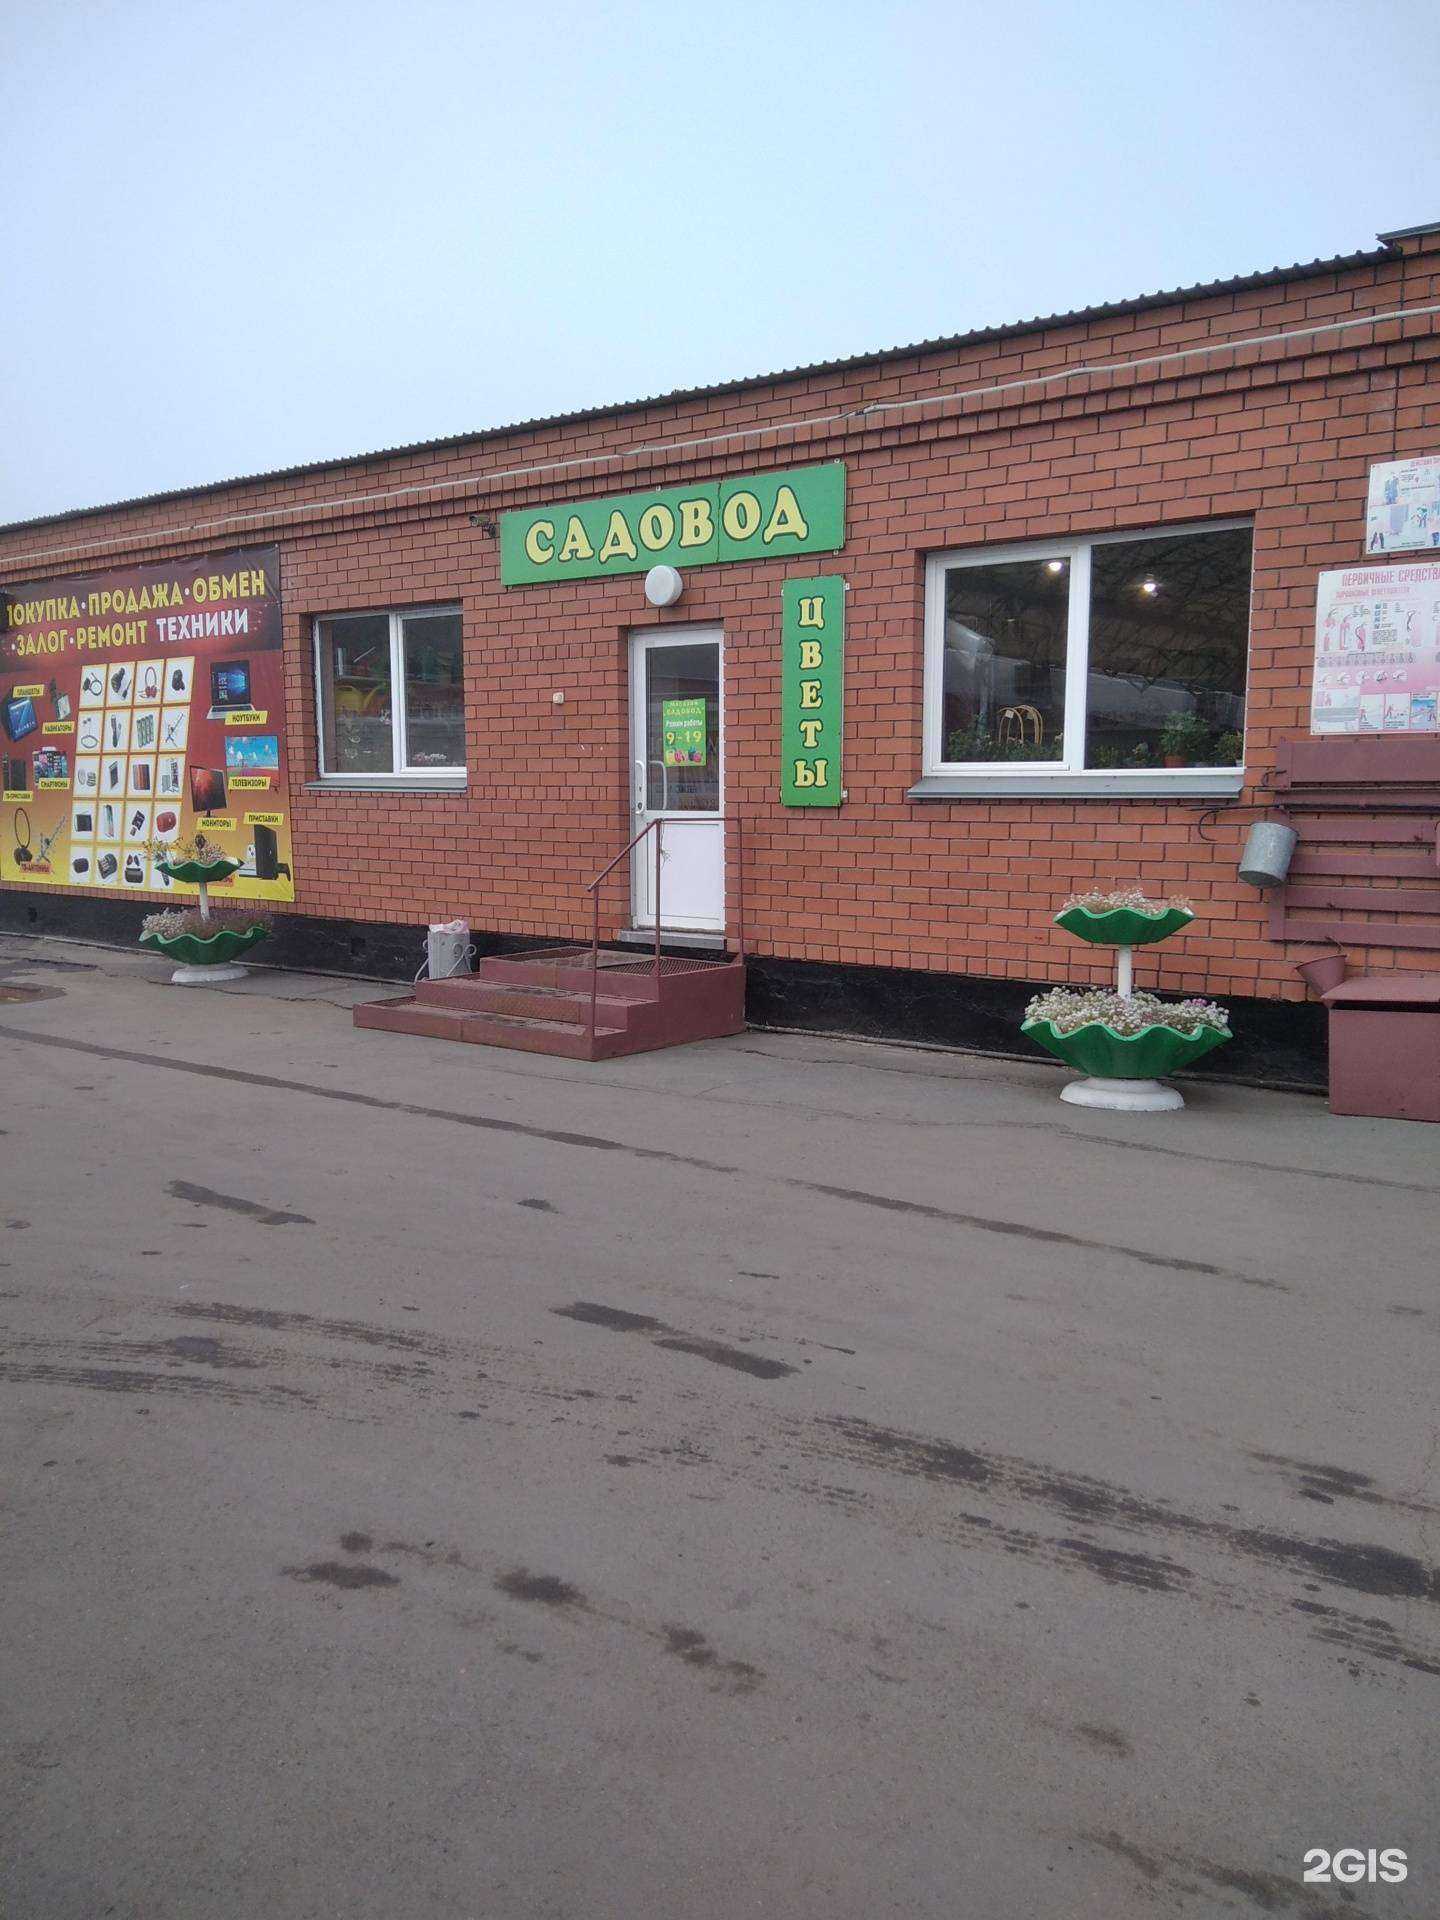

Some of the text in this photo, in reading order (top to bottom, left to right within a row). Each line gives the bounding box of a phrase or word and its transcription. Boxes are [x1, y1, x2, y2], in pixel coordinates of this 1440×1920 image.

[525, 485, 809, 564] САДОВОД
[88, 581, 184, 616] ПРОДАЖА
[192, 569, 265, 603] ОБМЕН
[16, 608, 248, 656] ЗАЛОГ РЕМОНТ ТЕХНИКИ
[794, 596, 828, 787] ЦВЕТЫ
